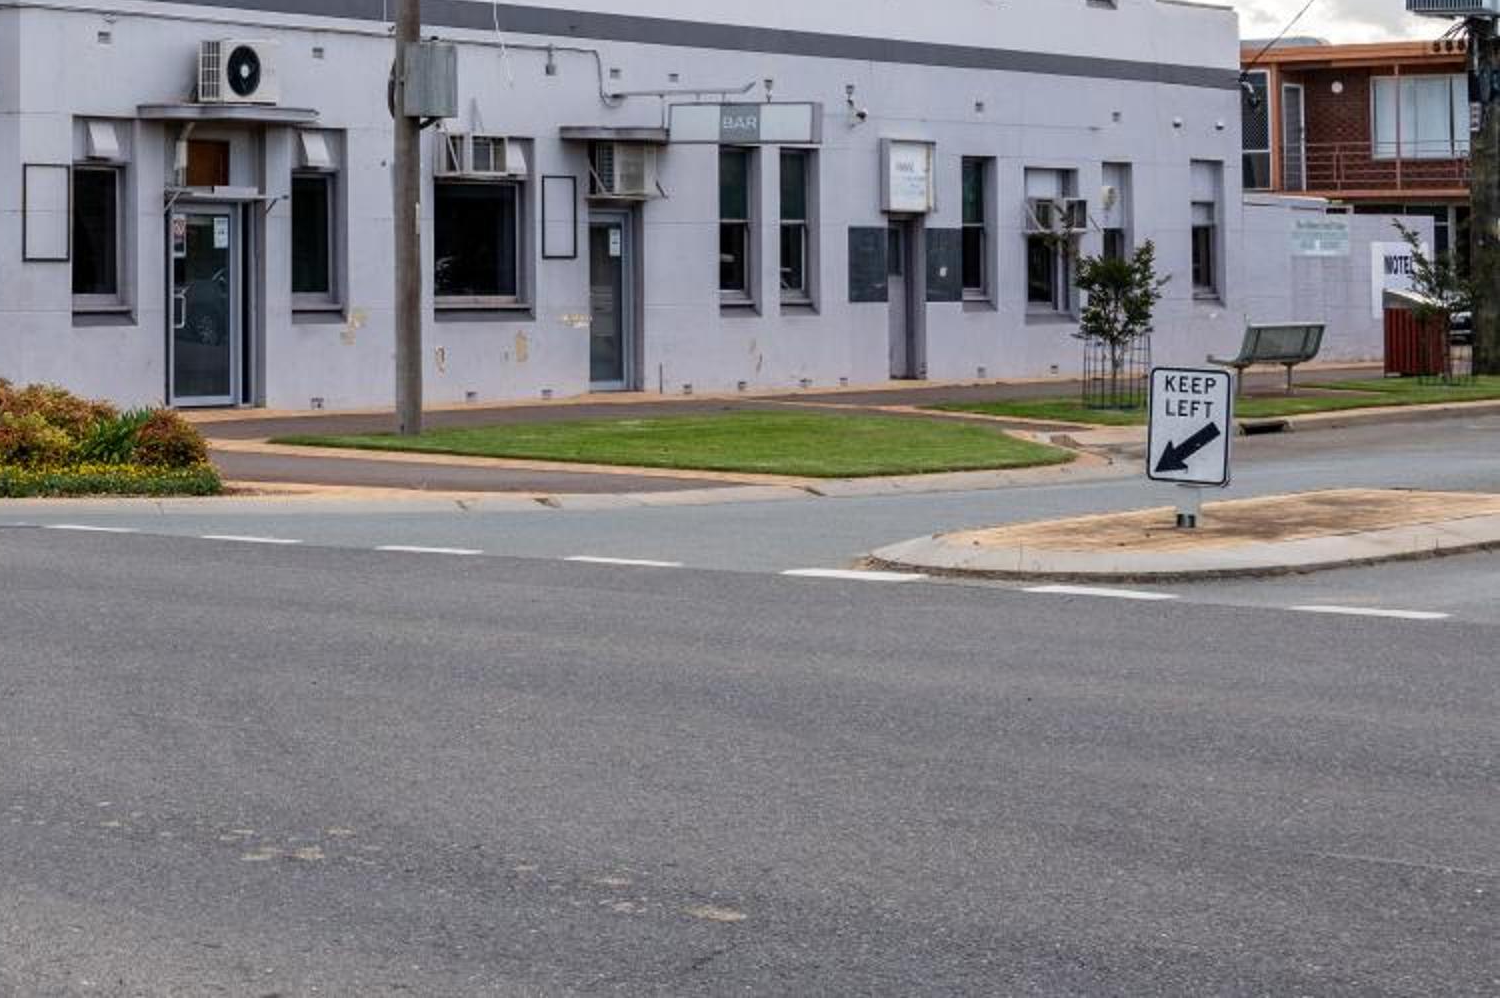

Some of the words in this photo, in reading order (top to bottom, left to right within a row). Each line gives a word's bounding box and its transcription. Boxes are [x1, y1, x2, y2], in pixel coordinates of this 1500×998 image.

[723, 116, 757, 129] BAR
[1165, 375, 1217, 394] KEEP
[1166, 399, 1213, 418] LEFT
